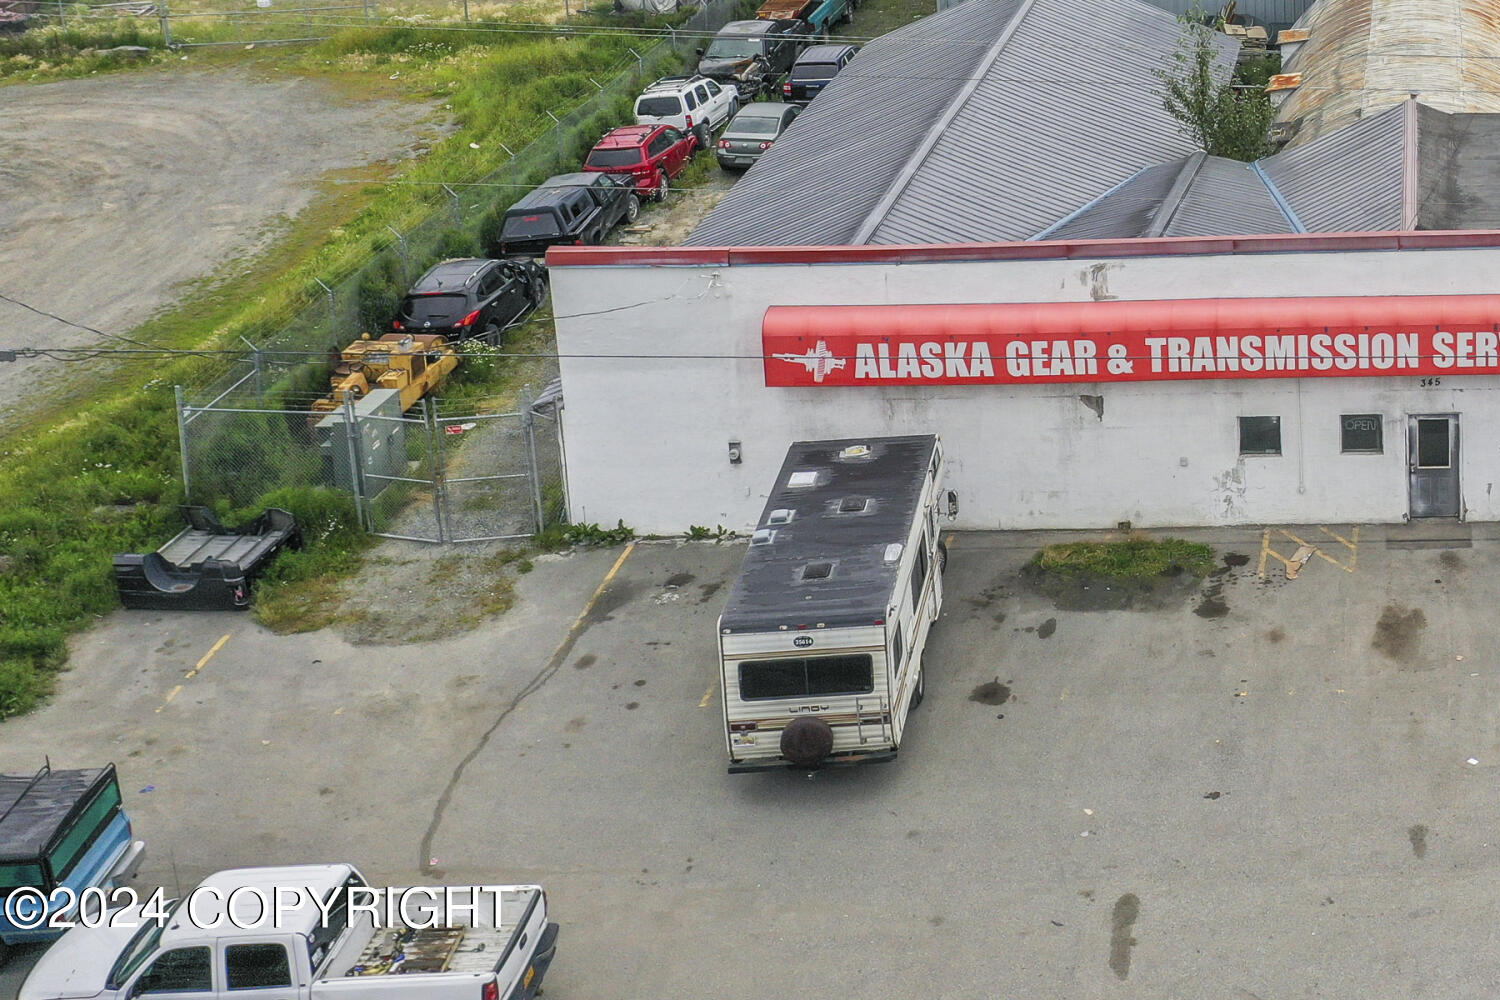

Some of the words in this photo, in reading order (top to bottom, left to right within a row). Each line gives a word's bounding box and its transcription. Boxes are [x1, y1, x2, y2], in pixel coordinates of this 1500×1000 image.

[855, 342, 994, 378] ALASKA
[1006, 340, 1098, 376] GEAR
[1107, 344, 1134, 374] &
[1145, 333, 1419, 374] TRANSMISSION
[1345, 420, 1377, 431] OPEN
